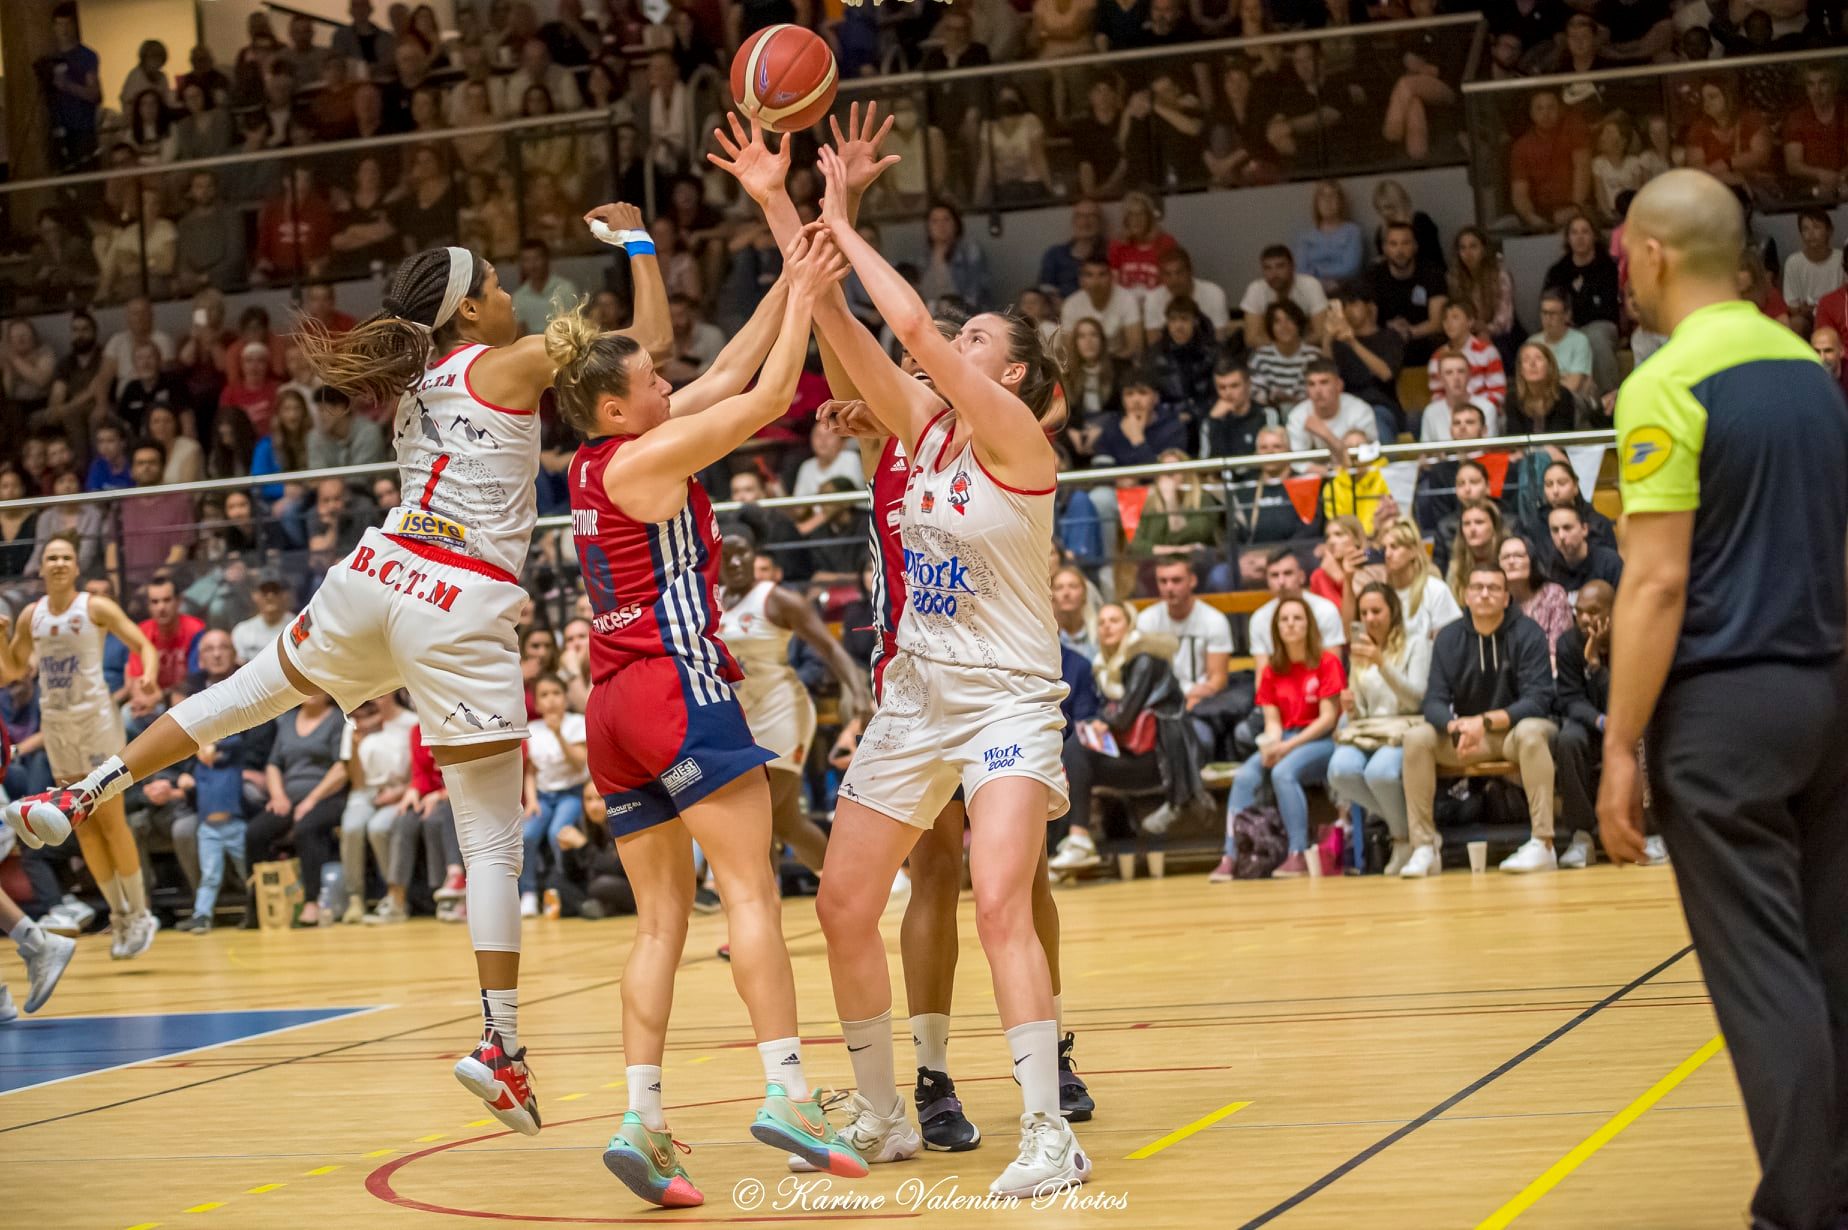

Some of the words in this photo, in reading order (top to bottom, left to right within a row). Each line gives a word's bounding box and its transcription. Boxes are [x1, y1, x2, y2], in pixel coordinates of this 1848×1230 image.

[420, 453, 450, 511] 1
[402, 509, 462, 539] isère
[350, 546, 462, 612] B.C.T.M
[903, 548, 979, 596] Work
[912, 590, 957, 617] 2000
[984, 744, 1024, 762] Work
[988, 758, 1015, 771] 2000
